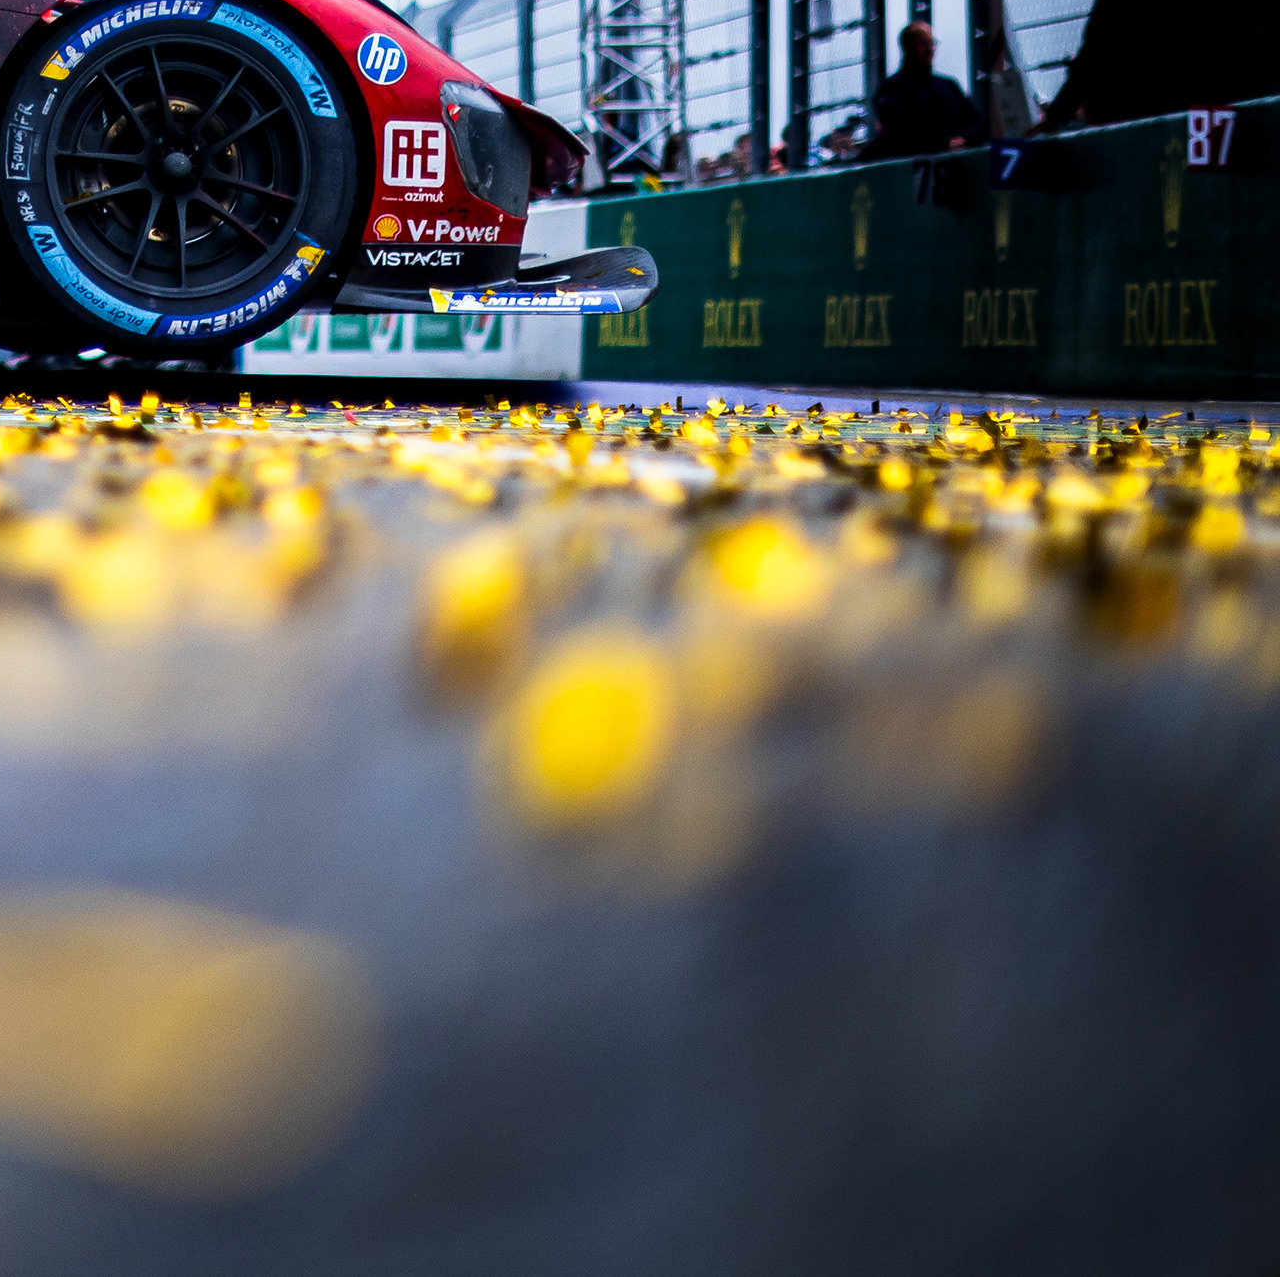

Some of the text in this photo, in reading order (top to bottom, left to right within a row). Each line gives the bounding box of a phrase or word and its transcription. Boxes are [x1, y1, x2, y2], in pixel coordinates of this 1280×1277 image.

[80, 0, 204, 49] MICHELIN
[225, 10, 261, 33] PILOT
[260, 30, 299, 61] SPORT
[365, 33, 402, 84] hp
[1187, 109, 1238, 167] 87
[999, 147, 1023, 182] 7
[403, 188, 444, 203] azimut
[407, 219, 501, 242] V-Power
[72, 282, 145, 327] PILOT SPORT
[166, 278, 289, 336] MICHELIN
[486, 296, 603, 306] MICHELIN
[703, 298, 763, 347] ROLEX
[824, 294, 893, 347] ROLEX
[962, 287, 1040, 347] ROLEX
[1124, 279, 1218, 348] ROLEX
